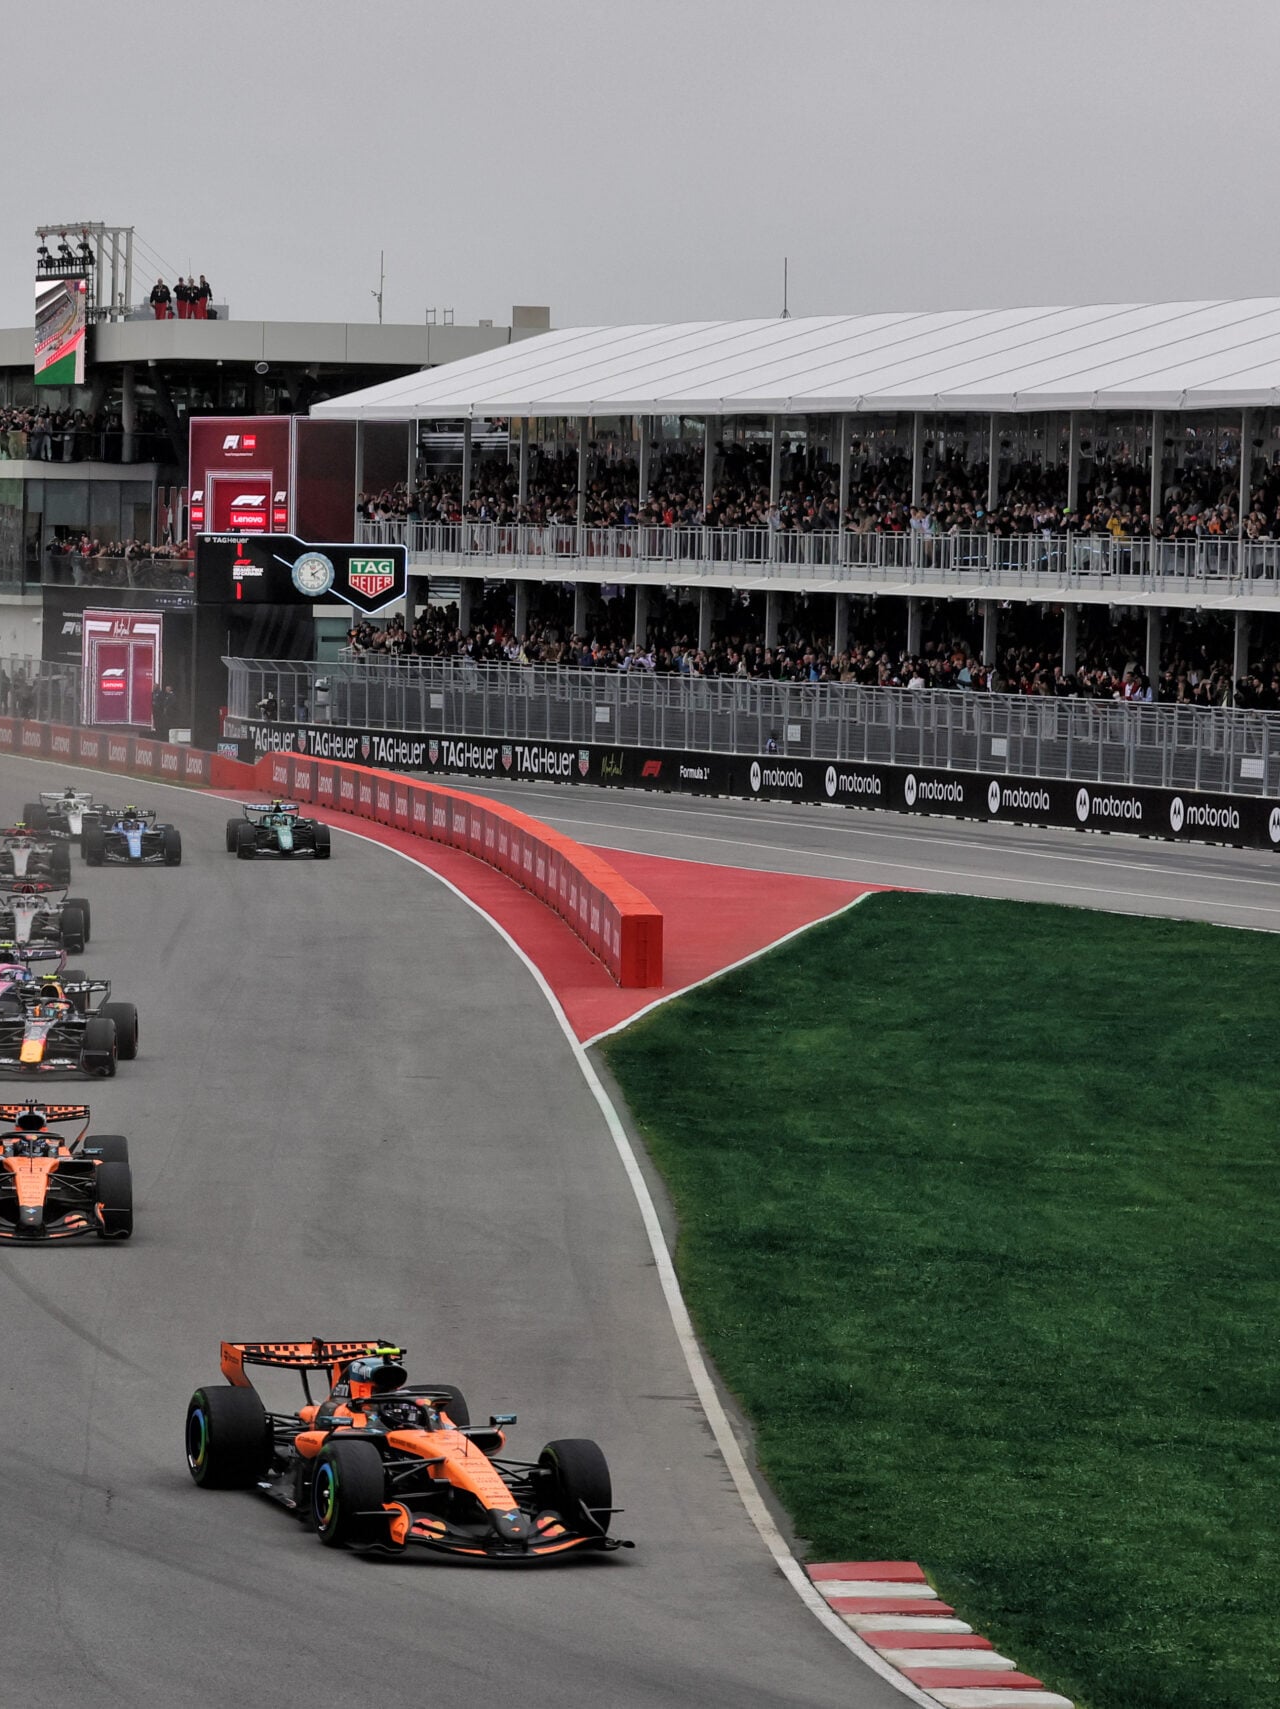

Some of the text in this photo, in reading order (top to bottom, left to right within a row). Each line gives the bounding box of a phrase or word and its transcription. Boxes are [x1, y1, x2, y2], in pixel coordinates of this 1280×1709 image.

[233, 515, 263, 523] Lenovo
[352, 561, 390, 573] TAG
[352, 576, 391, 595] HEUER
[22, 724, 41, 748] Lenovo
[51, 731, 70, 753] Lenovo
[80, 736, 99, 758] Lenovo
[308, 730, 358, 759] TAGHeuer
[109, 741, 127, 763] Lenovo
[135, 745, 153, 767] Lenovo
[161, 750, 178, 771] Lenovo
[372, 735, 426, 765] TAGHeuer
[441, 741, 498, 771] TAGHeuer
[514, 746, 575, 776] TAGHeuer
[185, 752, 202, 775] Lenovo
[272, 761, 287, 784] Lenovo
[680, 765, 703, 779] Formula
[295, 768, 310, 789] Lenovo
[318, 770, 332, 794] Lenovo
[341, 776, 354, 799] Lenovo
[762, 767, 803, 788] motorola
[838, 774, 882, 795] motorola
[360, 781, 371, 804] Lenovo
[378, 786, 389, 810] Lenovo
[919, 781, 964, 802] motorola
[1002, 788, 1050, 811] motorola
[396, 792, 408, 816] Lenovo
[414, 798, 426, 822] Lenovo
[433, 802, 446, 828] Lenovo
[1092, 796, 1142, 820] motorola
[1186, 803, 1240, 829] motorola
